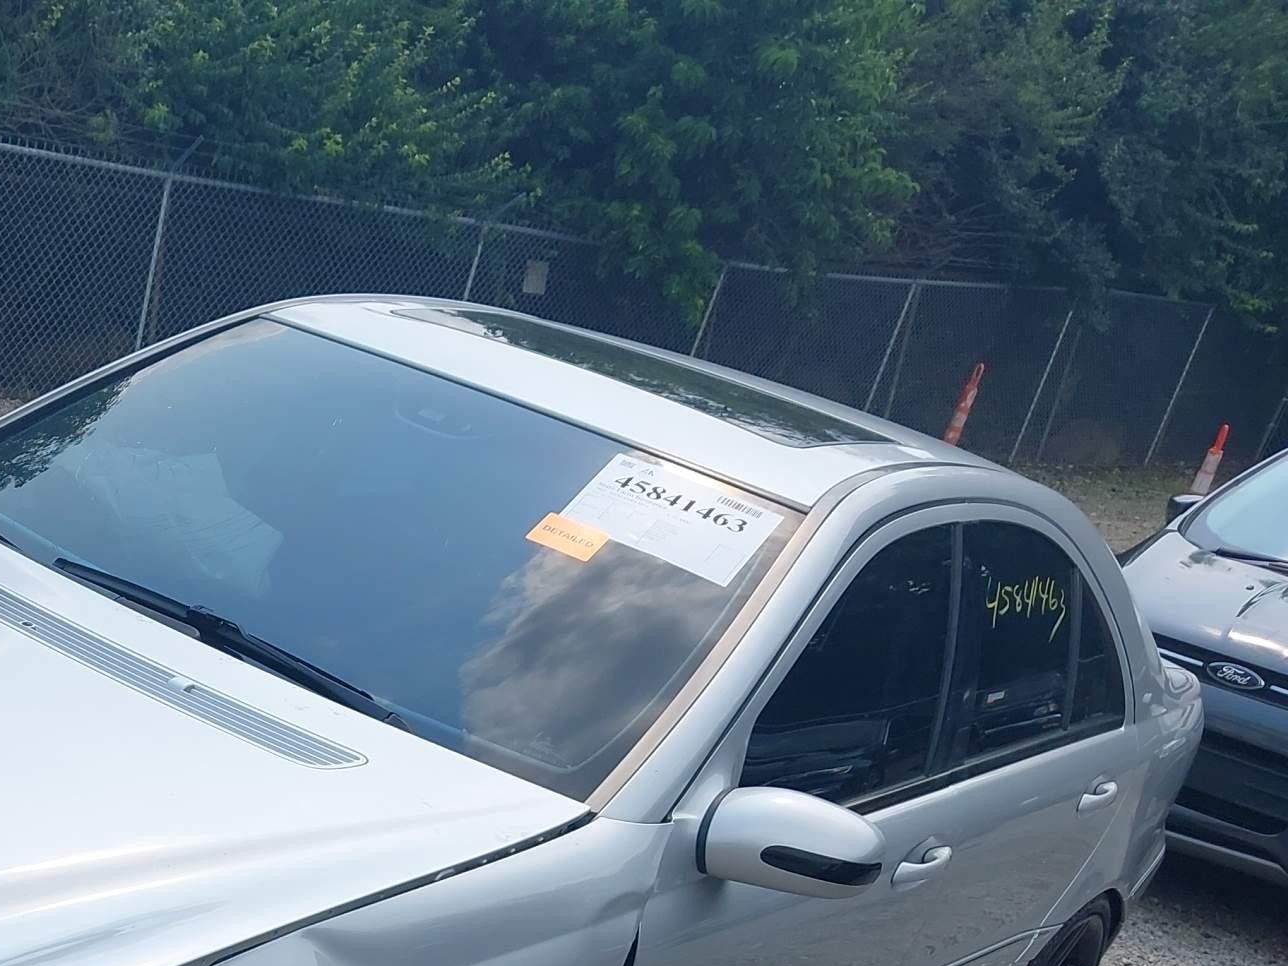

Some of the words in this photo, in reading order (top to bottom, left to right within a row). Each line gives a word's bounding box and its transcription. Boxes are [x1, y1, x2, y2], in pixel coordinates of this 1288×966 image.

[614, 475, 749, 534] 45841463
[541, 524, 595, 548] DETAILED
[985, 575, 1066, 644] 45841463
[1216, 665, 1252, 686] Ford
